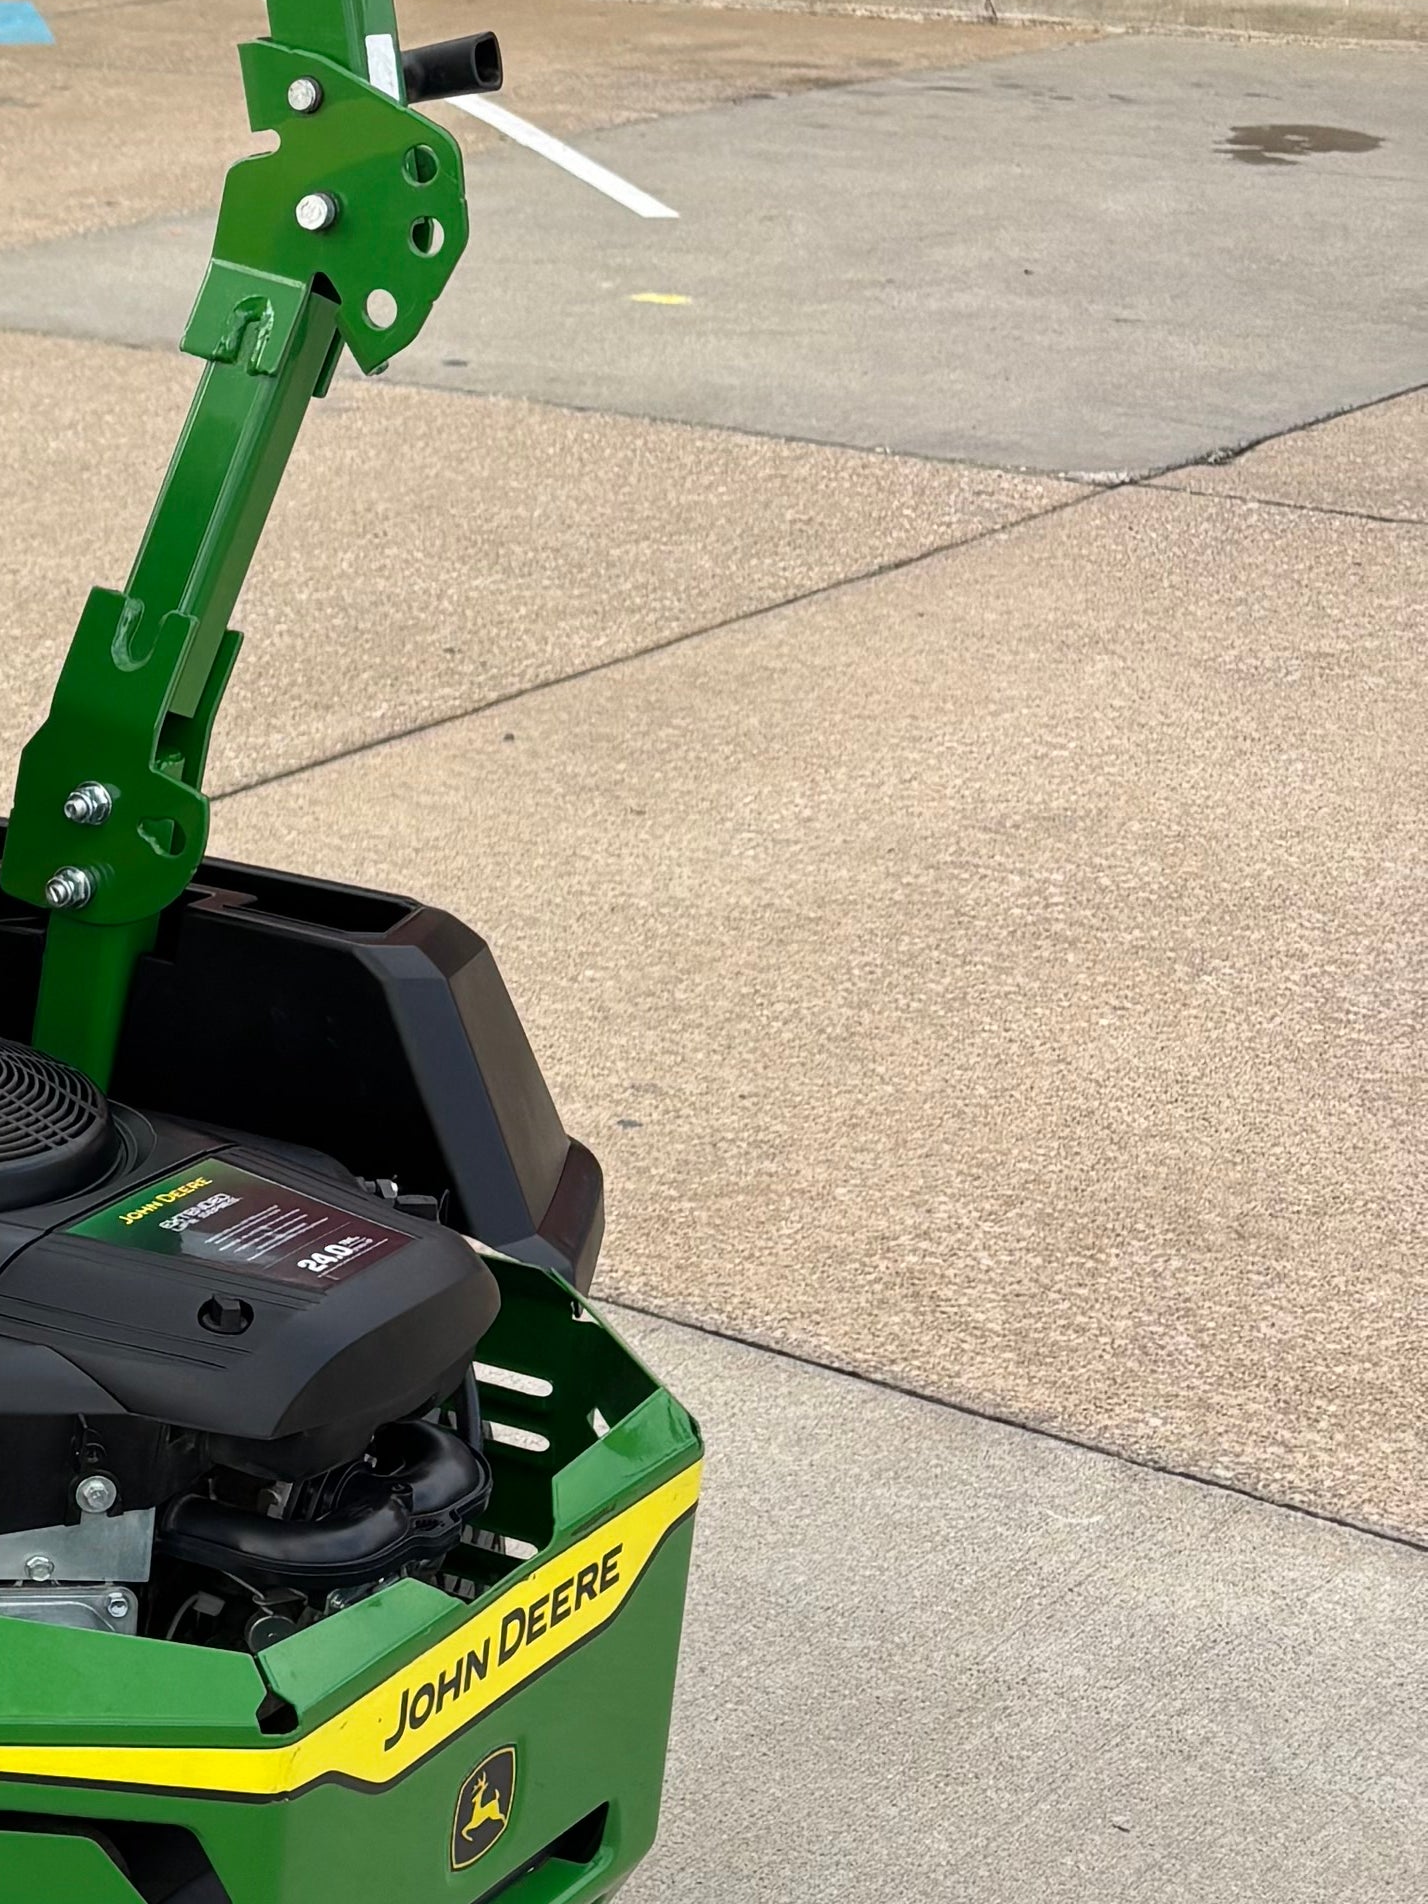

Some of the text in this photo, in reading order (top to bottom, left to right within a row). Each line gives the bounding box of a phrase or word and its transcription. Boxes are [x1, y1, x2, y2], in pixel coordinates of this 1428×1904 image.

[119, 1177, 213, 1224] JOHN DEERE
[159, 1193, 231, 1229] EXTENDED
[298, 1244, 353, 1272] 24.0
[383, 1542, 623, 1752] JOHN DEERE
